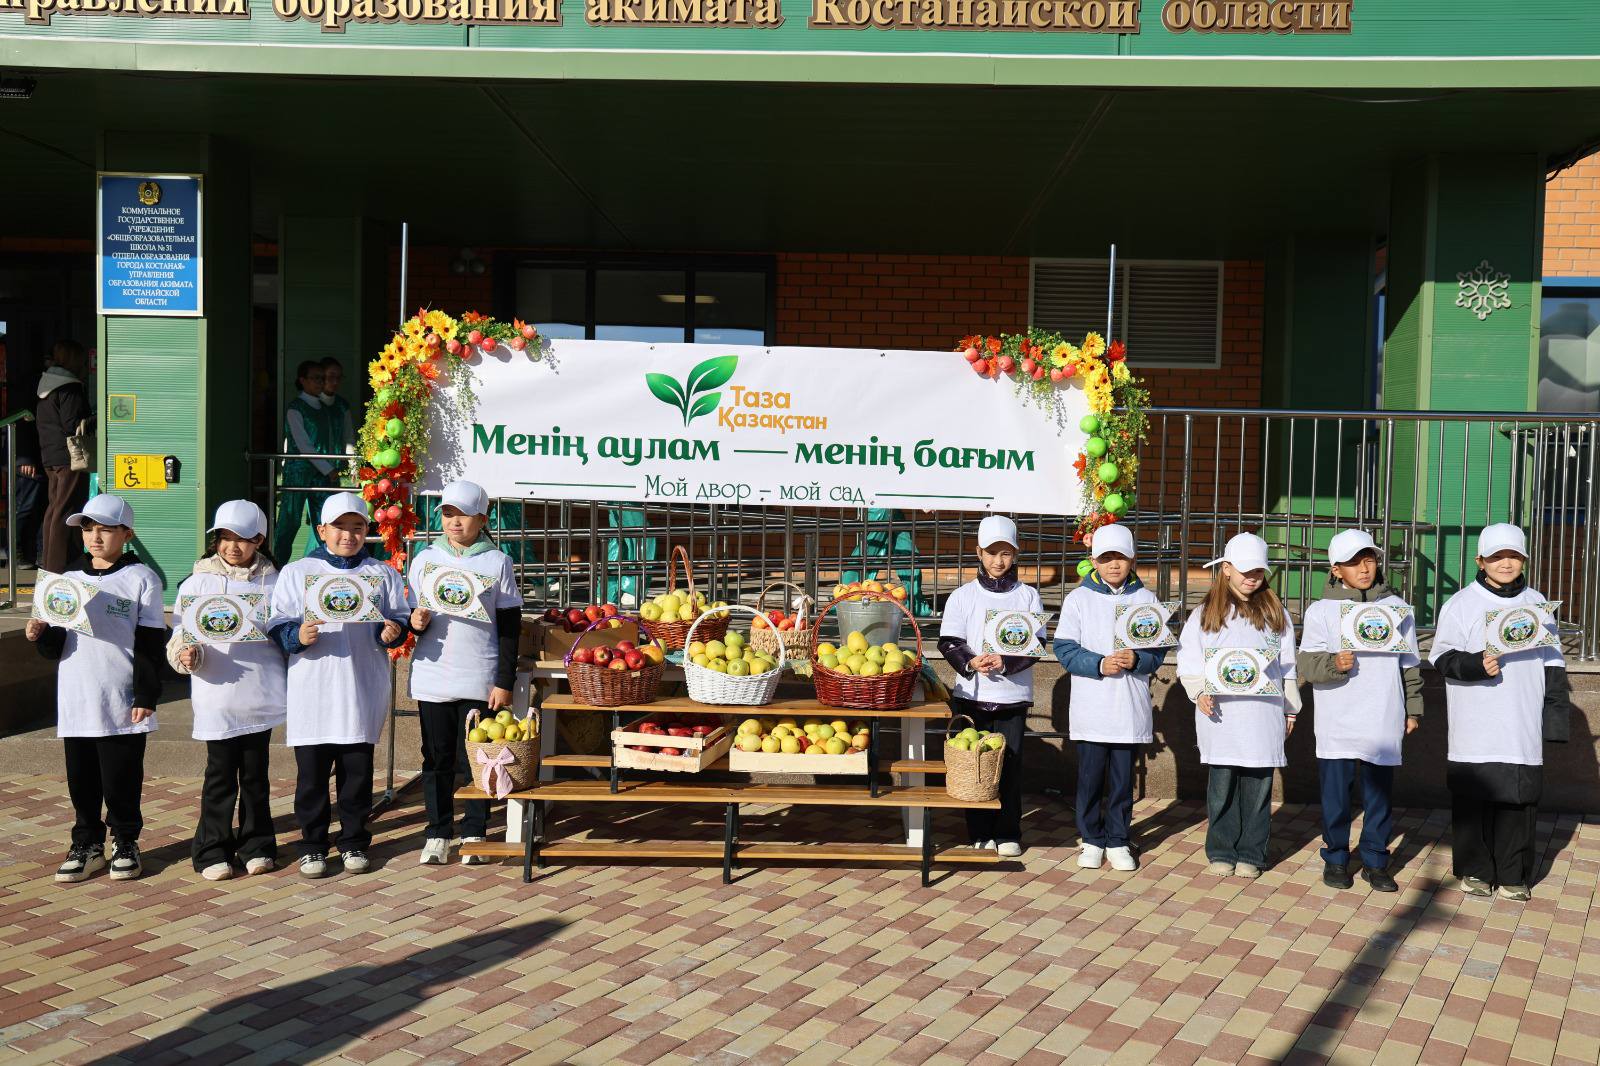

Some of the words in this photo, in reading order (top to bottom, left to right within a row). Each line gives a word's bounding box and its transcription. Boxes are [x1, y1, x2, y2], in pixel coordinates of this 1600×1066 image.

[587, 0, 780, 24] акимата
[1165, 0, 1351, 30] области
[121, 206, 181, 215] КОММУНАЛЬНОЕ
[117, 216, 185, 225] ГОСУДАРСТВЕННОЕ
[128, 225, 175, 233] УЧРЕЖДЕНИЕ
[130, 243, 157, 251] ШКОЛА
[111, 252, 140, 260] ОТДЕЛА
[141, 253, 190, 261] ОБРАЗОВАНИЯ
[117, 261, 145, 270] ГОРОДА
[129, 271, 174, 279] УПРАВЛЕНИЯ
[108, 279, 159, 288] ОБРАЗОВАНИЯ
[160, 280, 194, 288] АКИМАТА
[122, 288, 180, 297] КОСТАНАЙСКОЙ
[135, 298, 168, 306] ОБЛАСТИ
[730, 385, 791, 409] Таза
[718, 406, 827, 434] Қазақстан
[471, 423, 589, 466] Менің
[597, 435, 721, 466] аулам
[794, 435, 906, 475] менің
[913, 438, 1036, 472] бағым
[644, 474, 689, 498] Мой
[695, 482, 751, 505] двор
[779, 481, 822, 501] мой
[829, 486, 866, 505] сад
